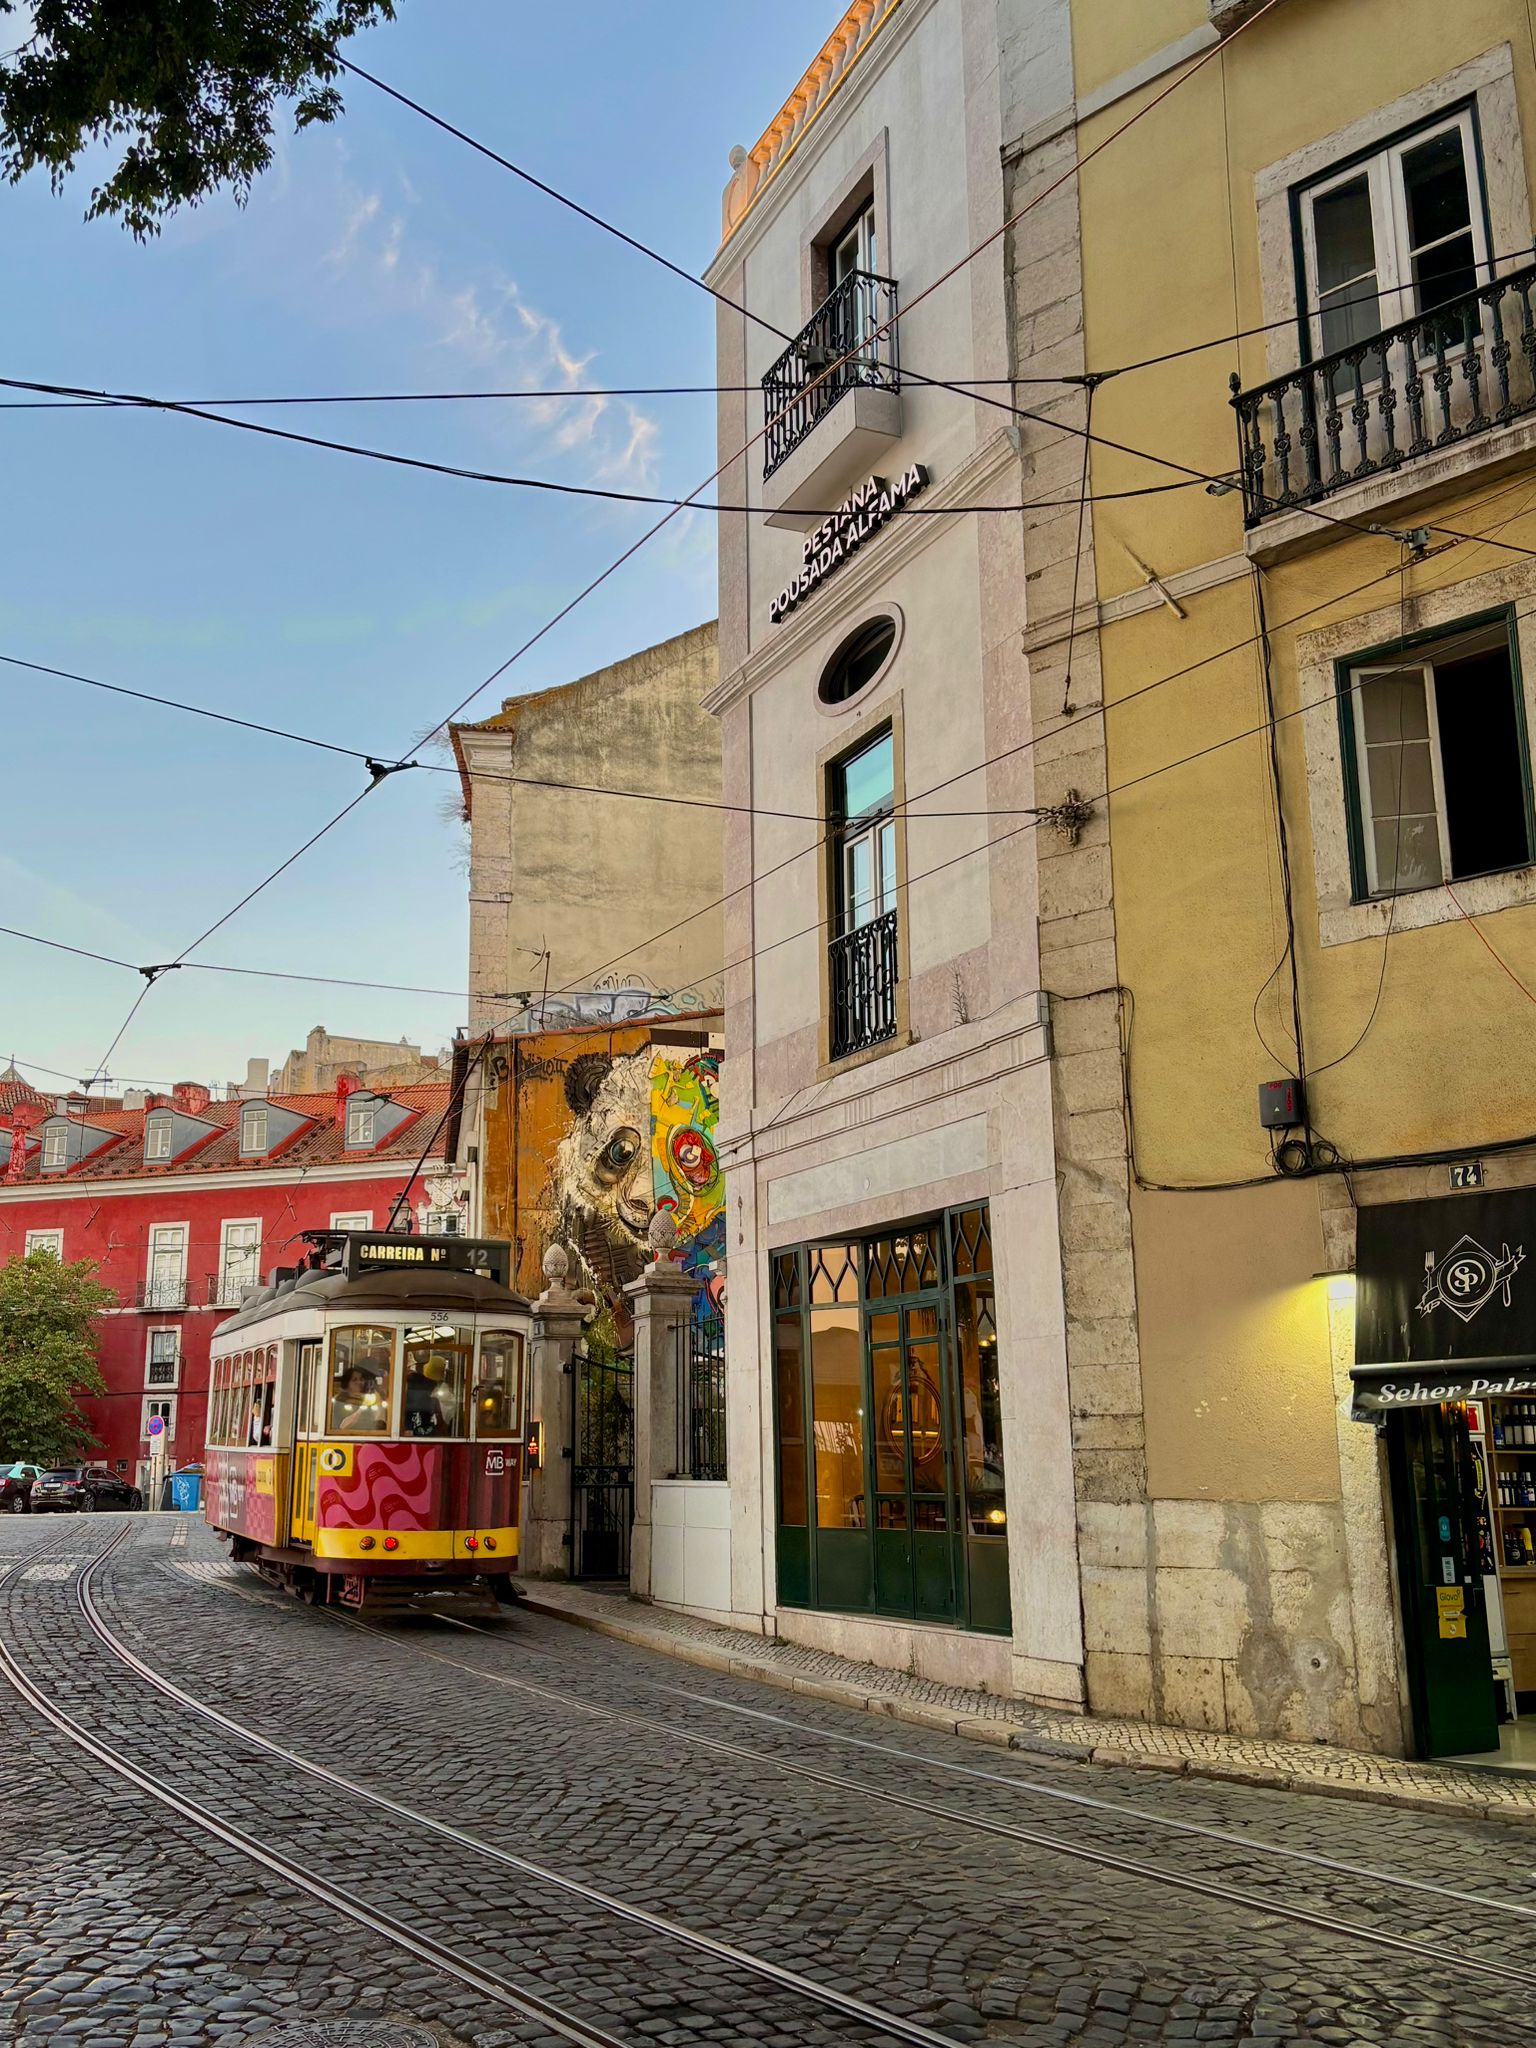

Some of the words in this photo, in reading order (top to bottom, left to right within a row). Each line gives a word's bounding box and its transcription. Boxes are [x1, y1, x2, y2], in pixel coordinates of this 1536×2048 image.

[802, 475, 879, 563] PESTANA
[769, 536, 844, 623] POUSADA
[846, 463, 921, 550] ALFAMA
[1453, 1165, 1478, 1186] 74
[360, 1244, 424, 1261] CARREIRA
[467, 1249, 488, 1265] 12
[430, 1312, 449, 1321] 556
[1377, 1382, 1462, 1403] Seher
[1467, 1377, 1536, 1396] Pala
